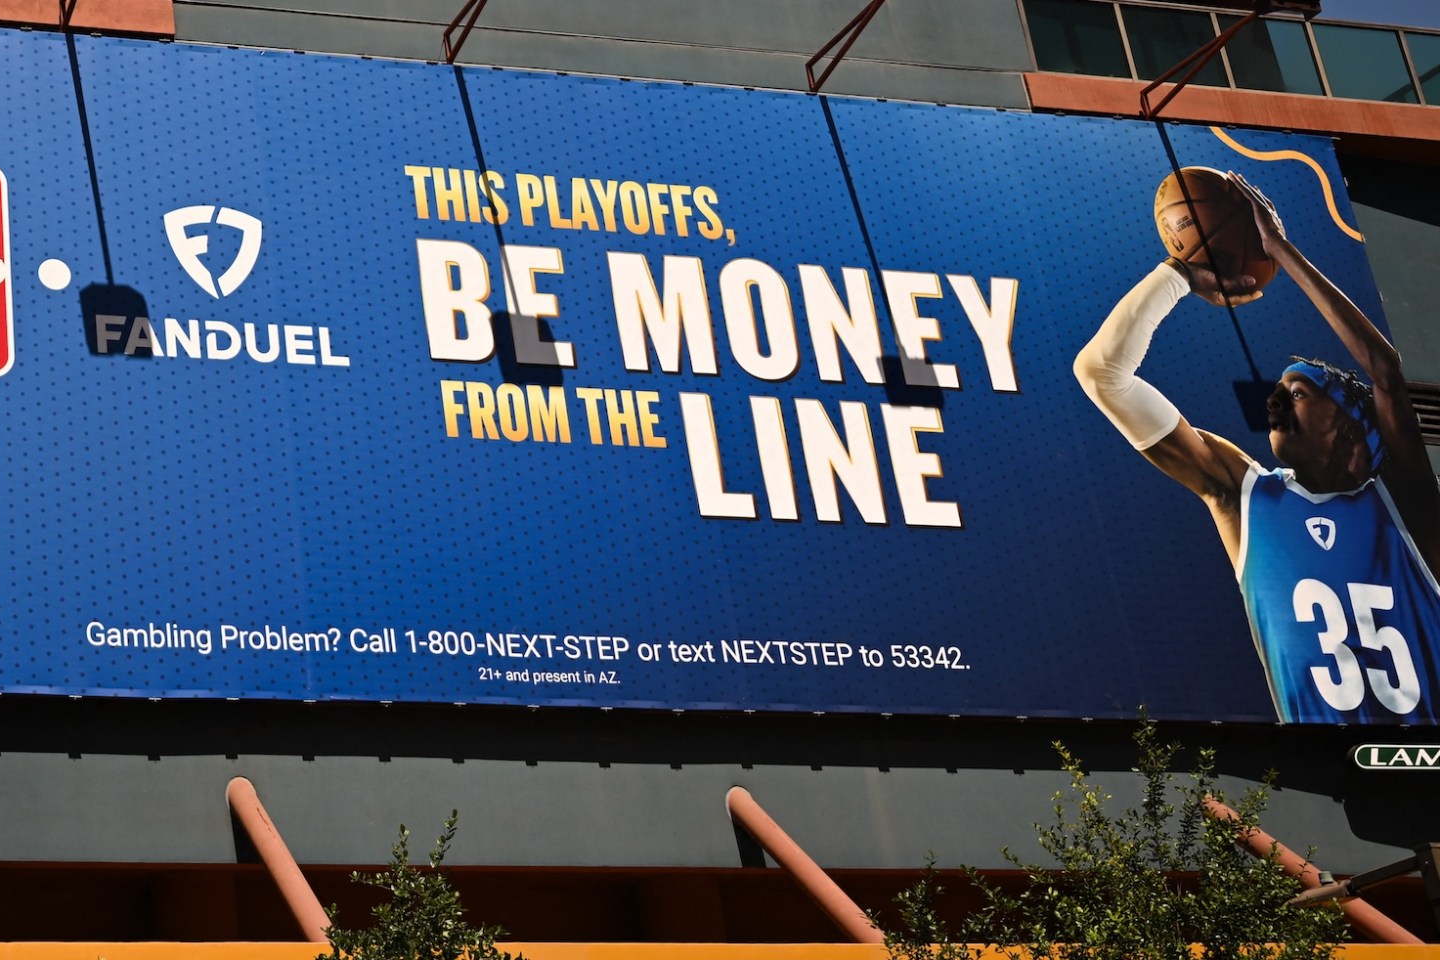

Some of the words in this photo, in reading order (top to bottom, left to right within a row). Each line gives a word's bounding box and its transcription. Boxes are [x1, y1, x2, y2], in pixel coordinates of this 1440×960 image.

[404, 166, 509, 225] THIS
[516, 174, 736, 246] PLAYOFFS,
[95, 314, 351, 367] FANDUEL
[415, 238, 575, 368] BE
[607, 250, 1019, 393] MONEY
[440, 380, 572, 444] FROM
[576, 387, 667, 449] THE
[678, 390, 962, 528] LINE
[86, 621, 212, 655] Gambling
[220, 624, 341, 652] Problem?
[349, 627, 397, 653] Call
[405, 630, 630, 660] 1-800-NEXT-STEP
[637, 642, 662, 662] or
[668, 640, 716, 663] text
[720, 639, 853, 666] NEXTSTEP
[858, 645, 884, 668] to
[890, 644, 971, 670] 53342.
[478, 667, 502, 680] 21+
[505, 668, 530, 682] and
[532, 670, 581, 685] present
[583, 670, 596, 683] in
[598, 671, 621, 684] AZ.
[1292, 578, 1421, 715] 35
